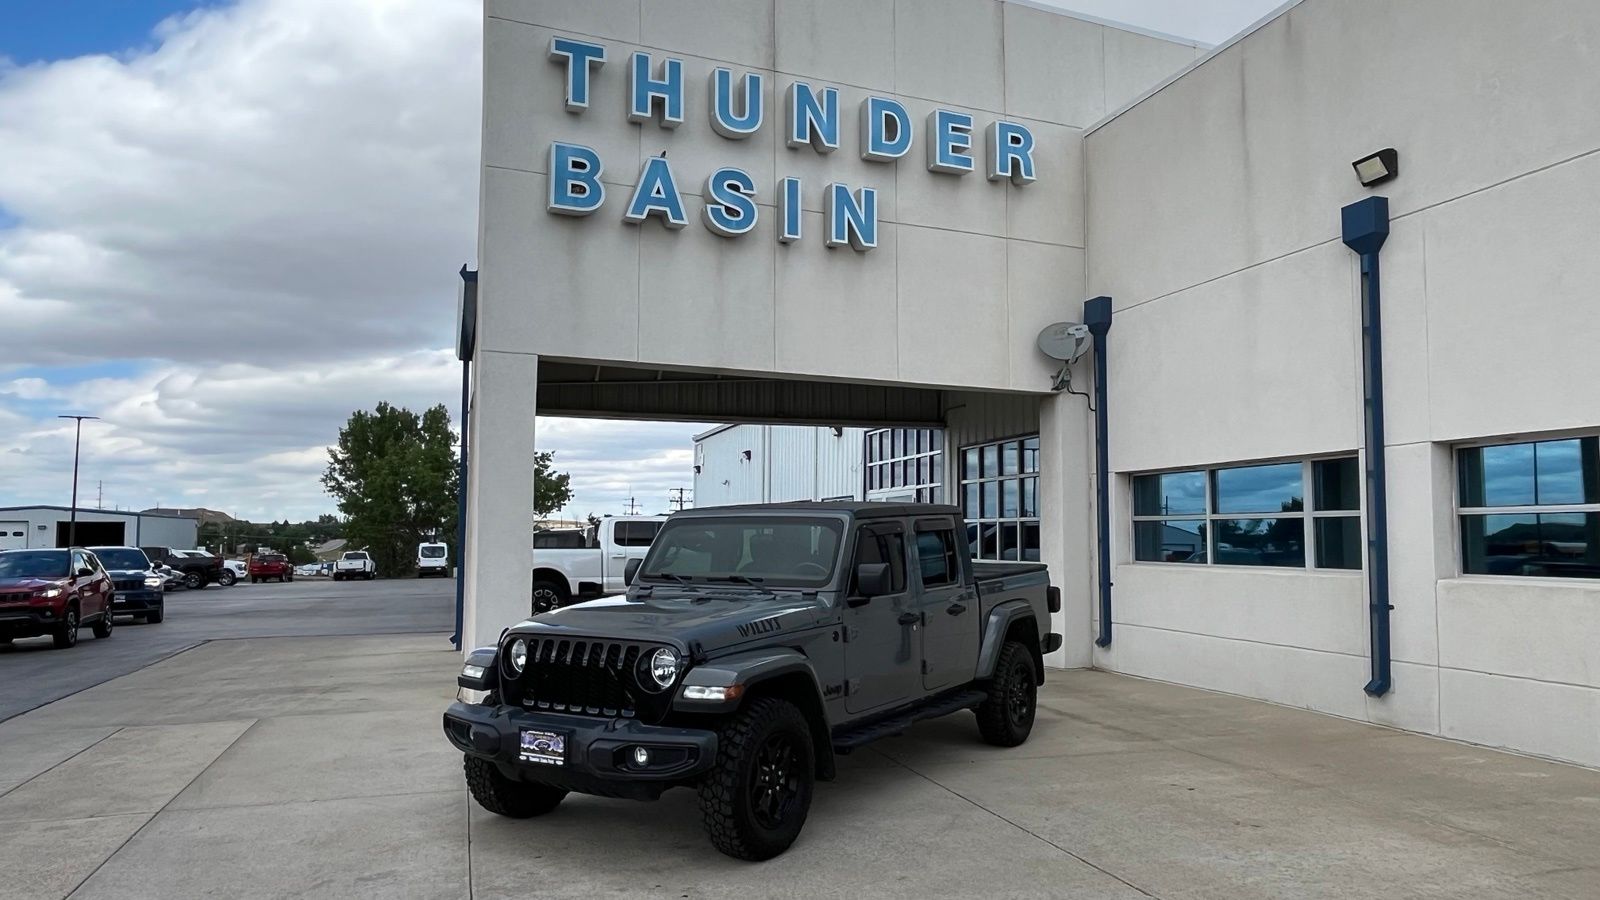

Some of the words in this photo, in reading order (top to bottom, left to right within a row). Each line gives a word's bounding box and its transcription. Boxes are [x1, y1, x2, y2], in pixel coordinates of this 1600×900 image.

[548, 36, 1037, 186] THUNDER
[547, 141, 878, 251] BASIN
[736, 617, 782, 638] WILLYS
